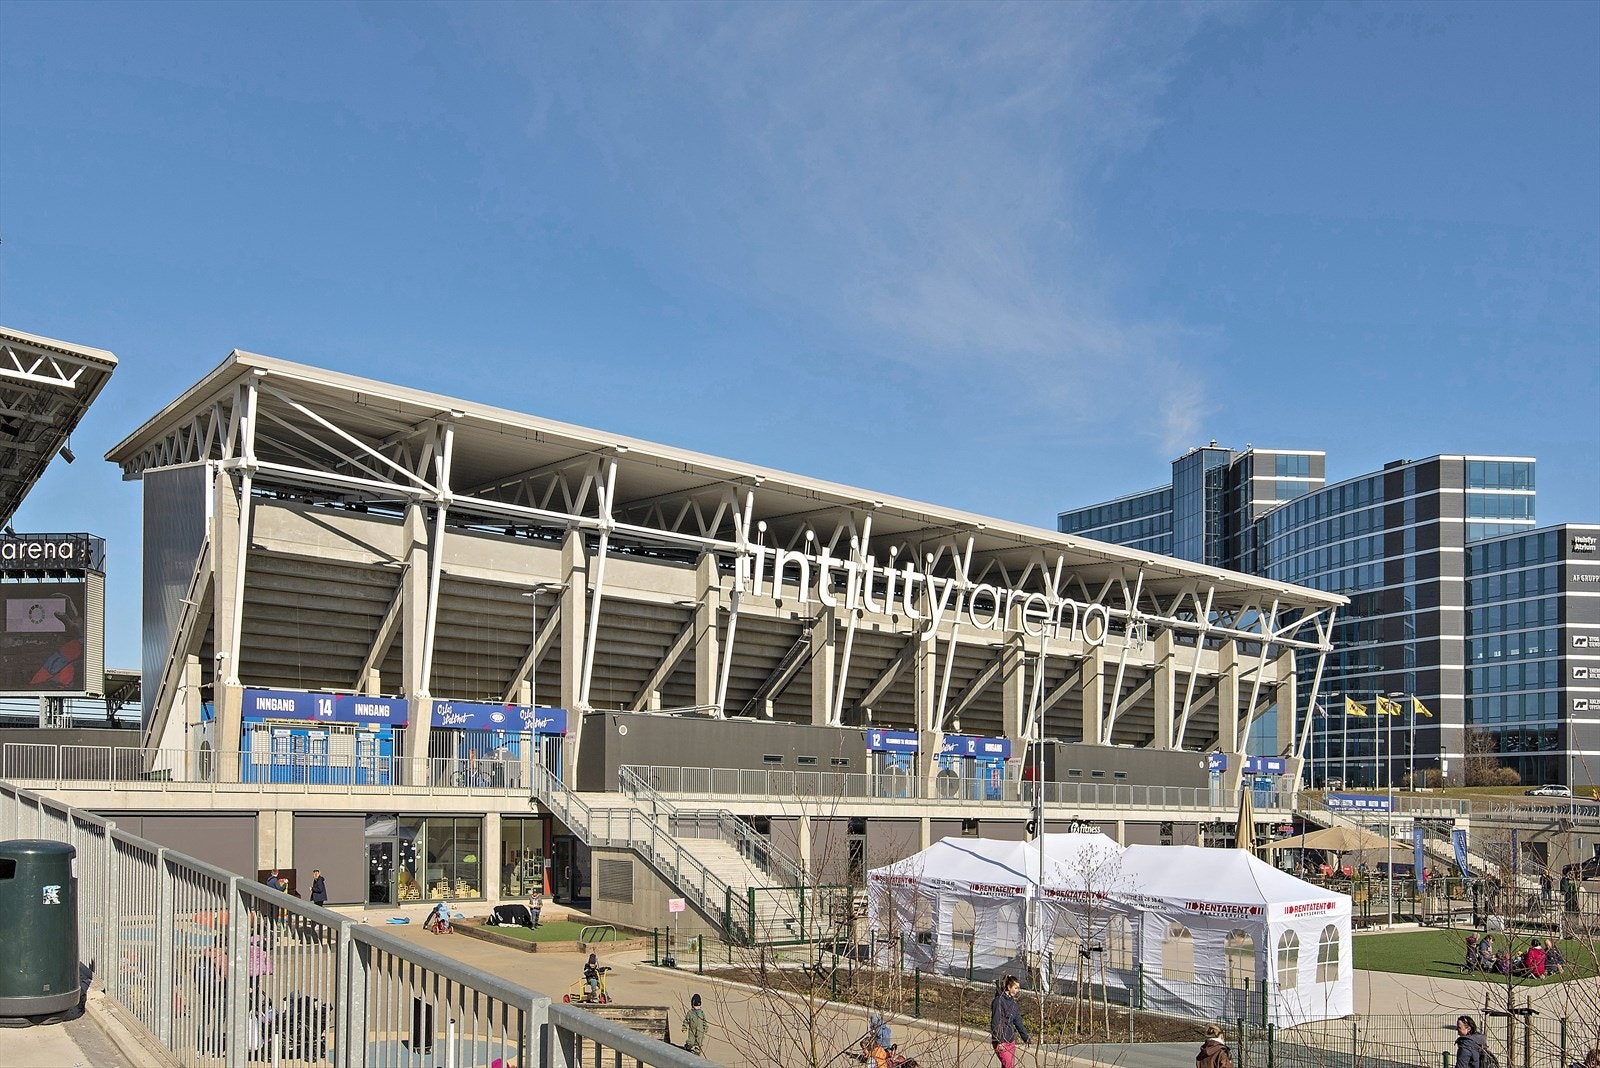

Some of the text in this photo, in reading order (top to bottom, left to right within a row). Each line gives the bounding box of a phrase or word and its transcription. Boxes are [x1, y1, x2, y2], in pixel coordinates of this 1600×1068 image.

[1, 542, 73, 560] arena
[969, 583, 1110, 646] arena
[256, 697, 390, 717] INNGANG 14 INNGANG
[872, 733, 881, 747] 12
[967, 740, 975, 753] 12
[979, 884, 1016, 894] RENTATENT
[1199, 902, 1250, 914] RENTATENT
[1294, 902, 1327, 913] RENTATENT
[1200, 911, 1248, 919] PARTYSERVICE
[1294, 910, 1326, 918] PARTYSERVICE
